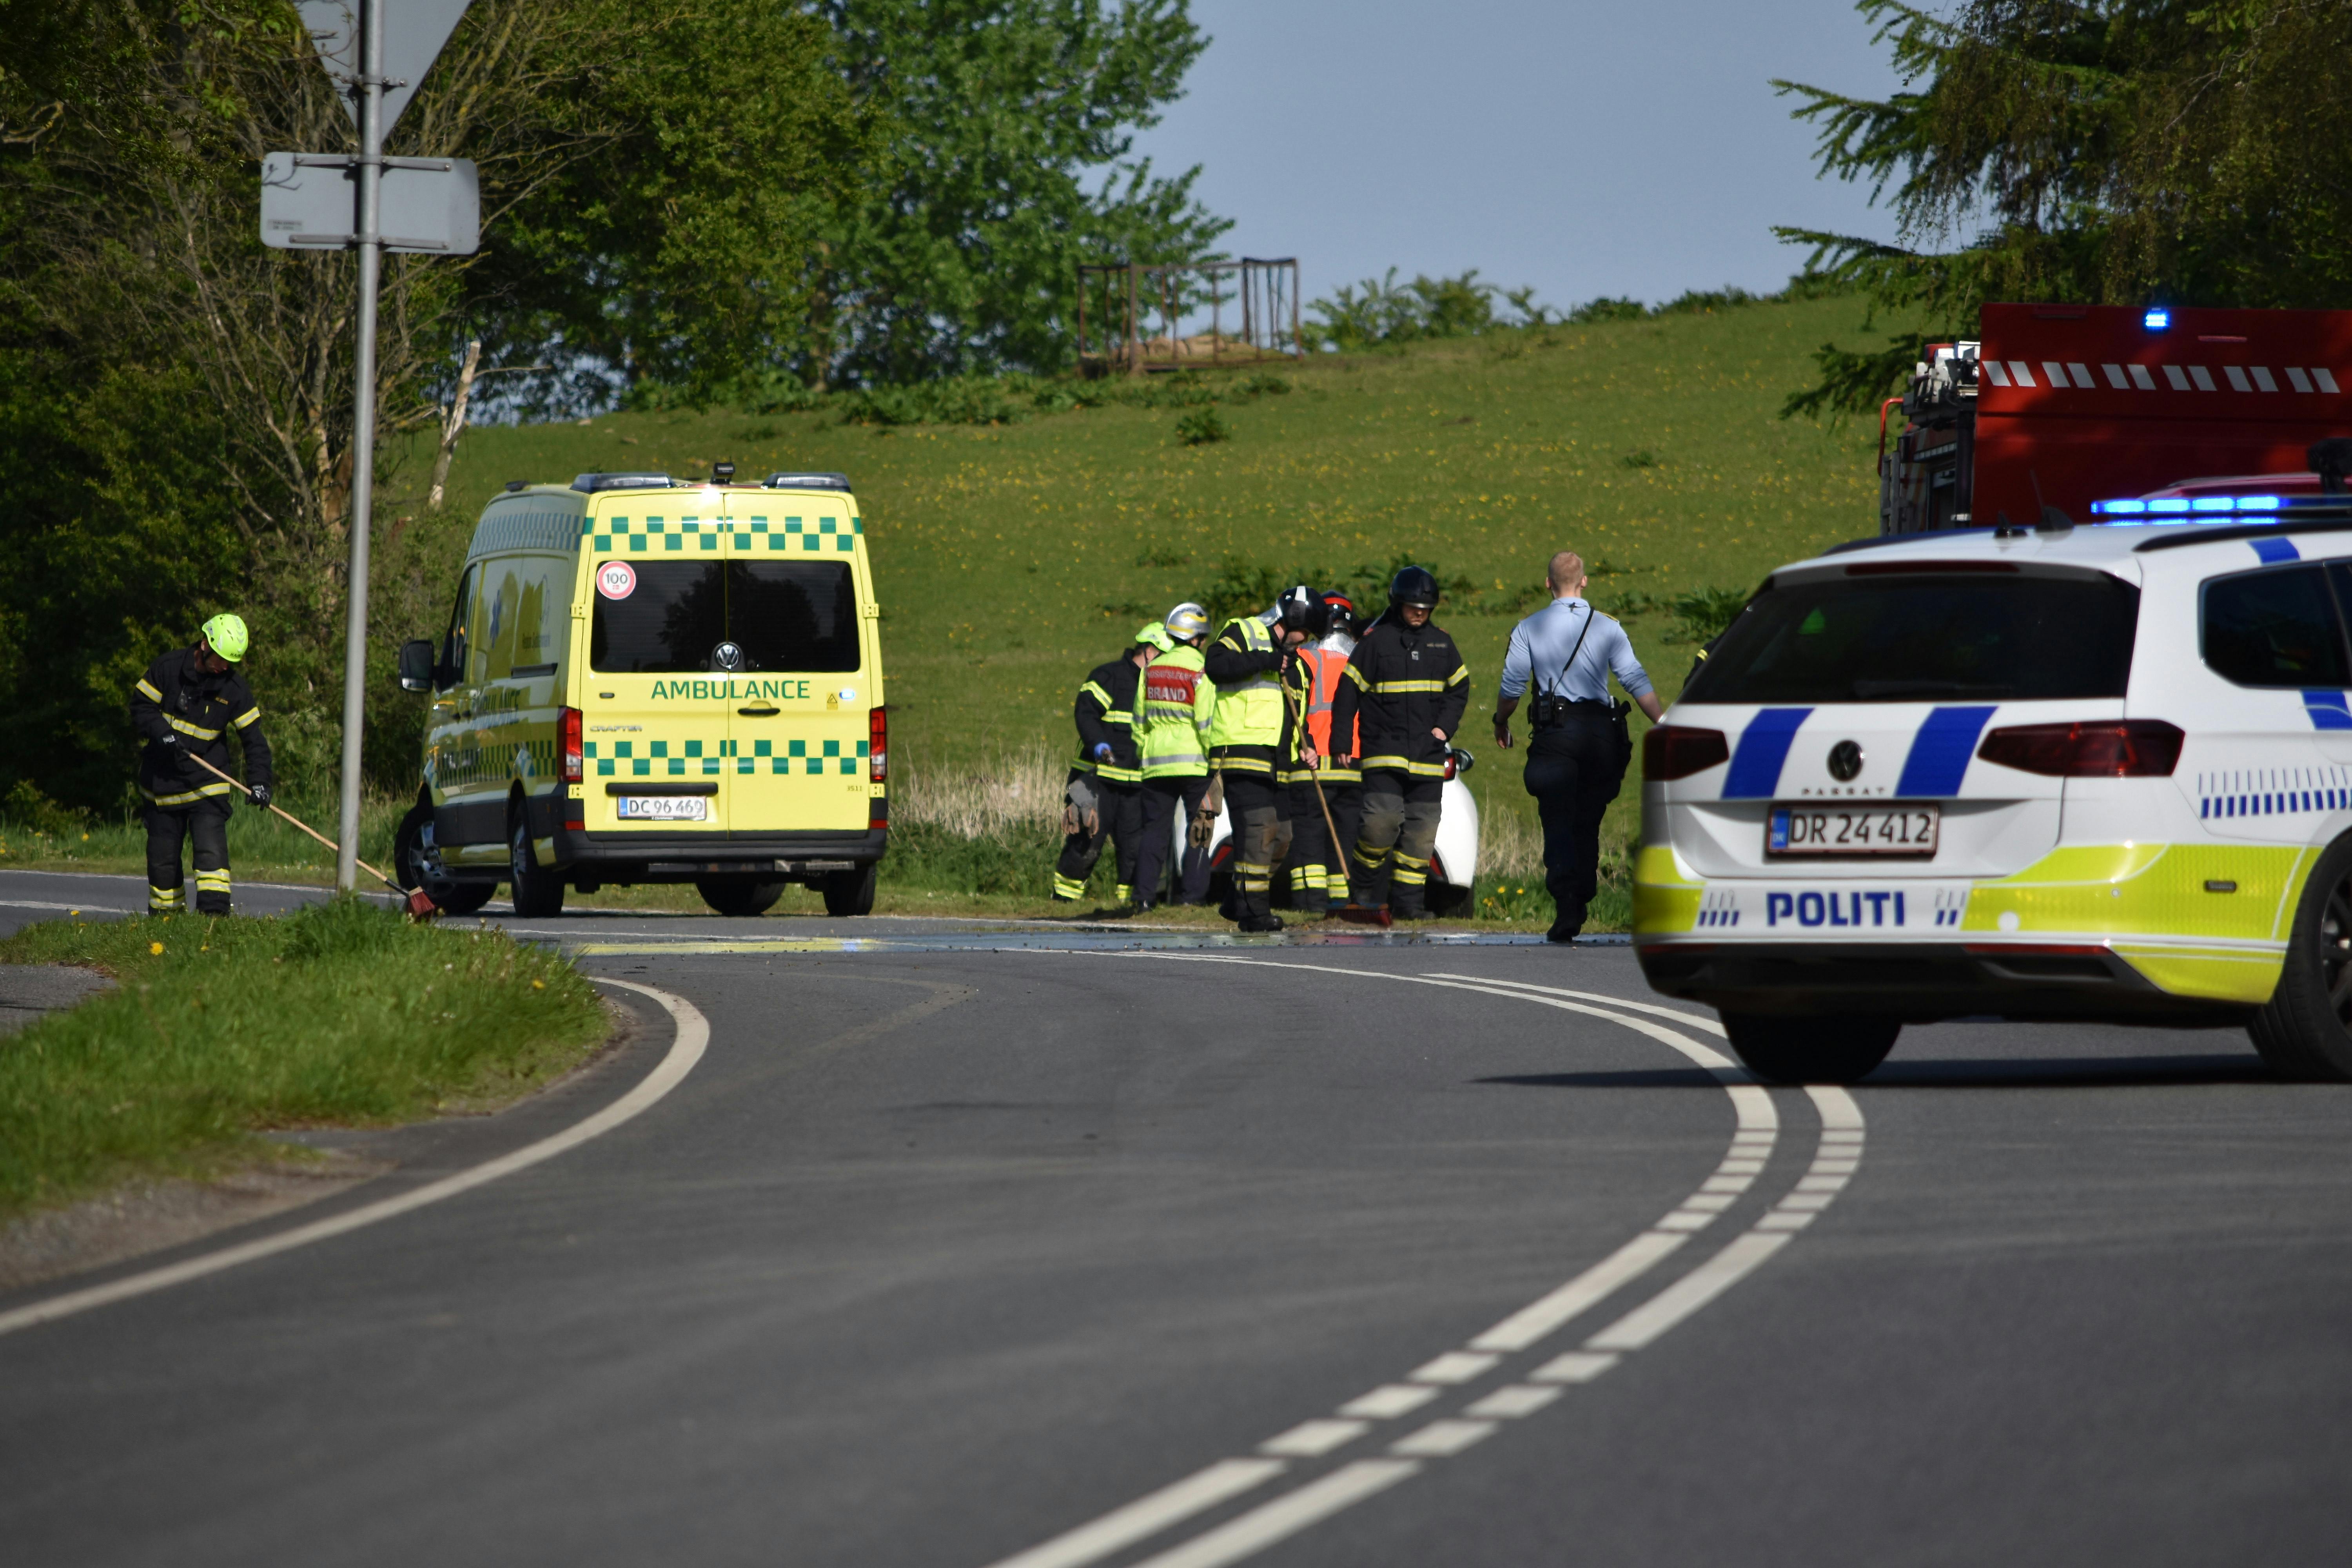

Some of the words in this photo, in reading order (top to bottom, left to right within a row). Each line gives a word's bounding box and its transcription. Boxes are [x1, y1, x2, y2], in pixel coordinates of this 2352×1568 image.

[606, 573, 628, 584] 100
[651, 681, 810, 699] AMBULANCE
[1147, 686, 1186, 701] BRAND
[630, 800, 650, 813] DC
[654, 800, 671, 813] 96
[676, 800, 703, 813] 469
[1791, 814, 1826, 843] DR
[1836, 814, 1870, 843] 24
[1878, 814, 1931, 843] 412
[1766, 891, 1904, 927] POLITI
